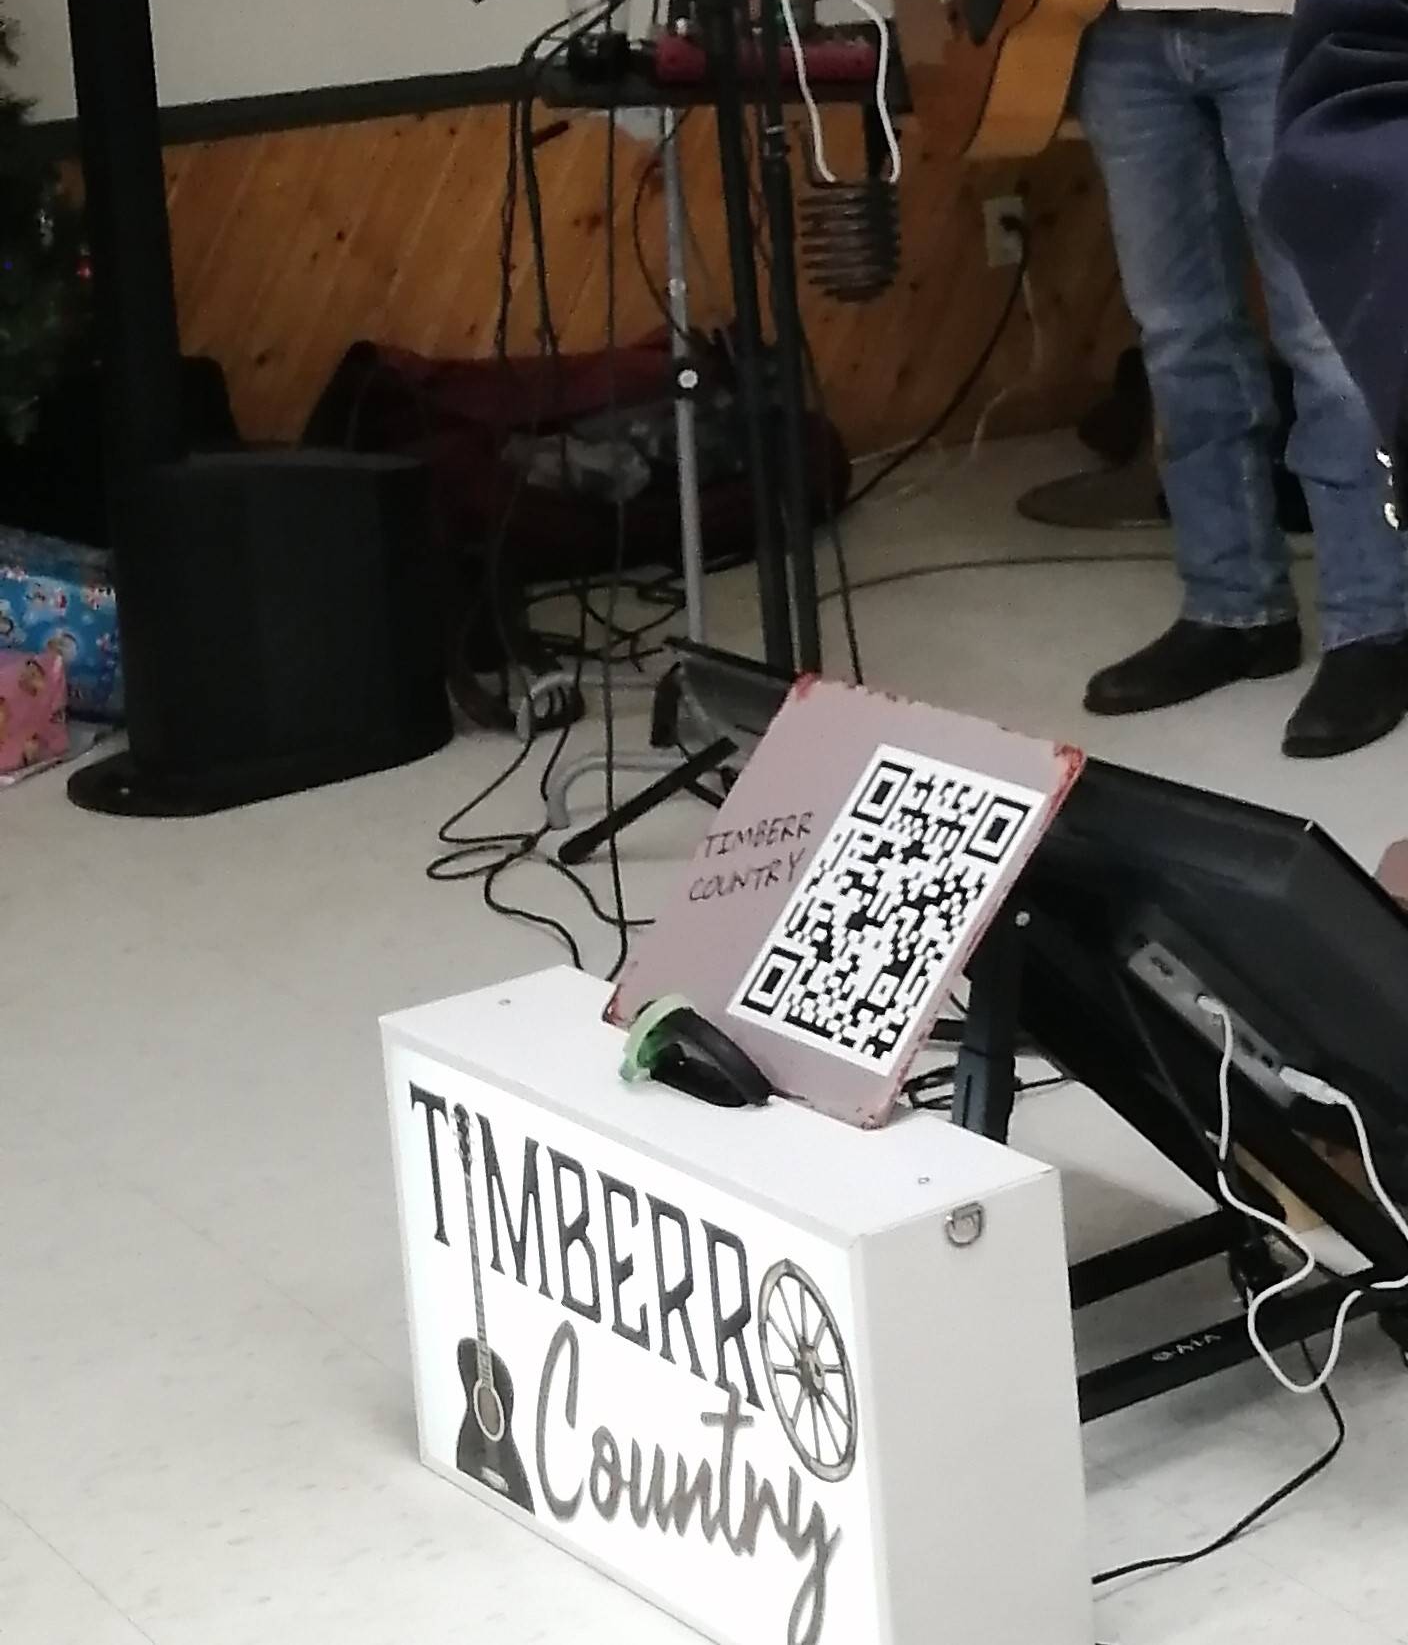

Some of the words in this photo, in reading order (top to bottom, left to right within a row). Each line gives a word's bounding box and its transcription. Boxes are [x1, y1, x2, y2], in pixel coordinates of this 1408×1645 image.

[704, 810, 813, 858] TIMBERR
[689, 848, 805, 901] COUNTRY
[536, 1320, 843, 1645] Country
